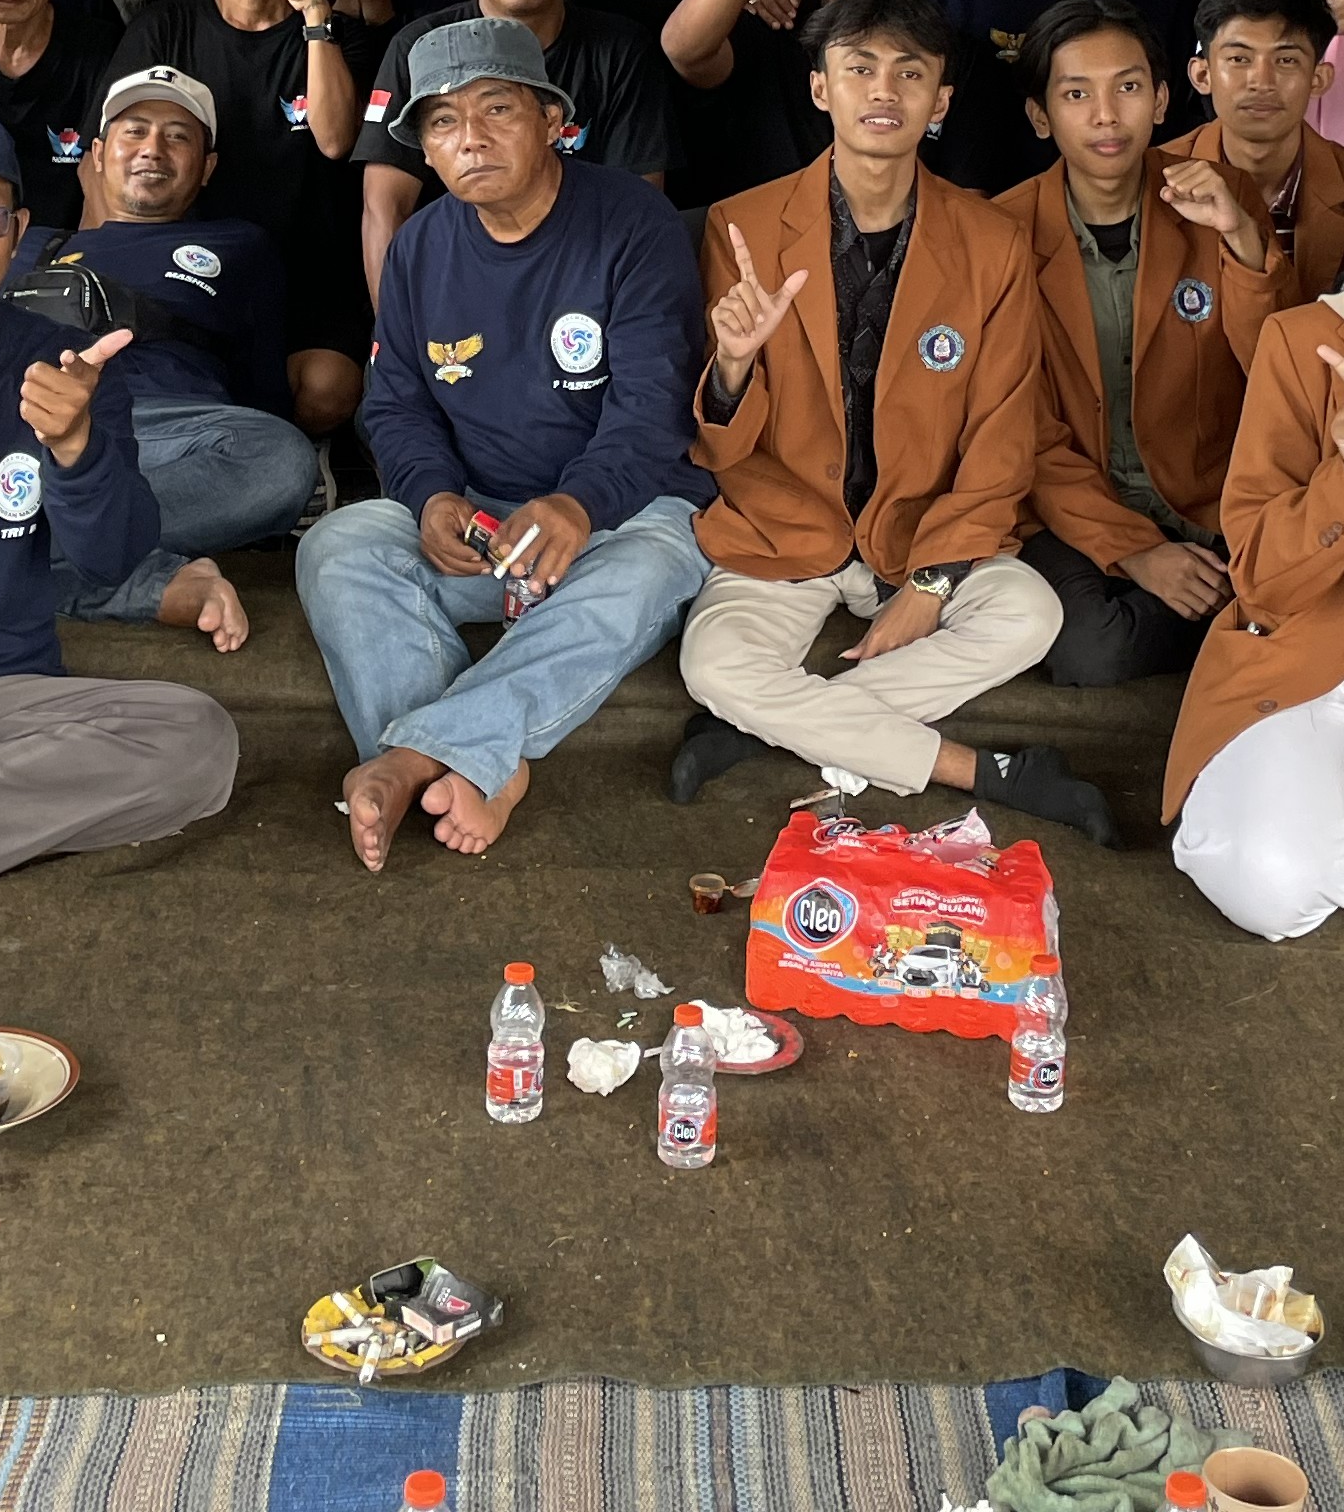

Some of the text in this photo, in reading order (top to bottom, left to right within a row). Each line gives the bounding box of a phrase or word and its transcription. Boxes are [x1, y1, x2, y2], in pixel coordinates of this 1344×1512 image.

[892, 896, 936, 908] SETIAP
[799, 898, 842, 934] Cleo
[674, 1123, 696, 1140] Cleo
